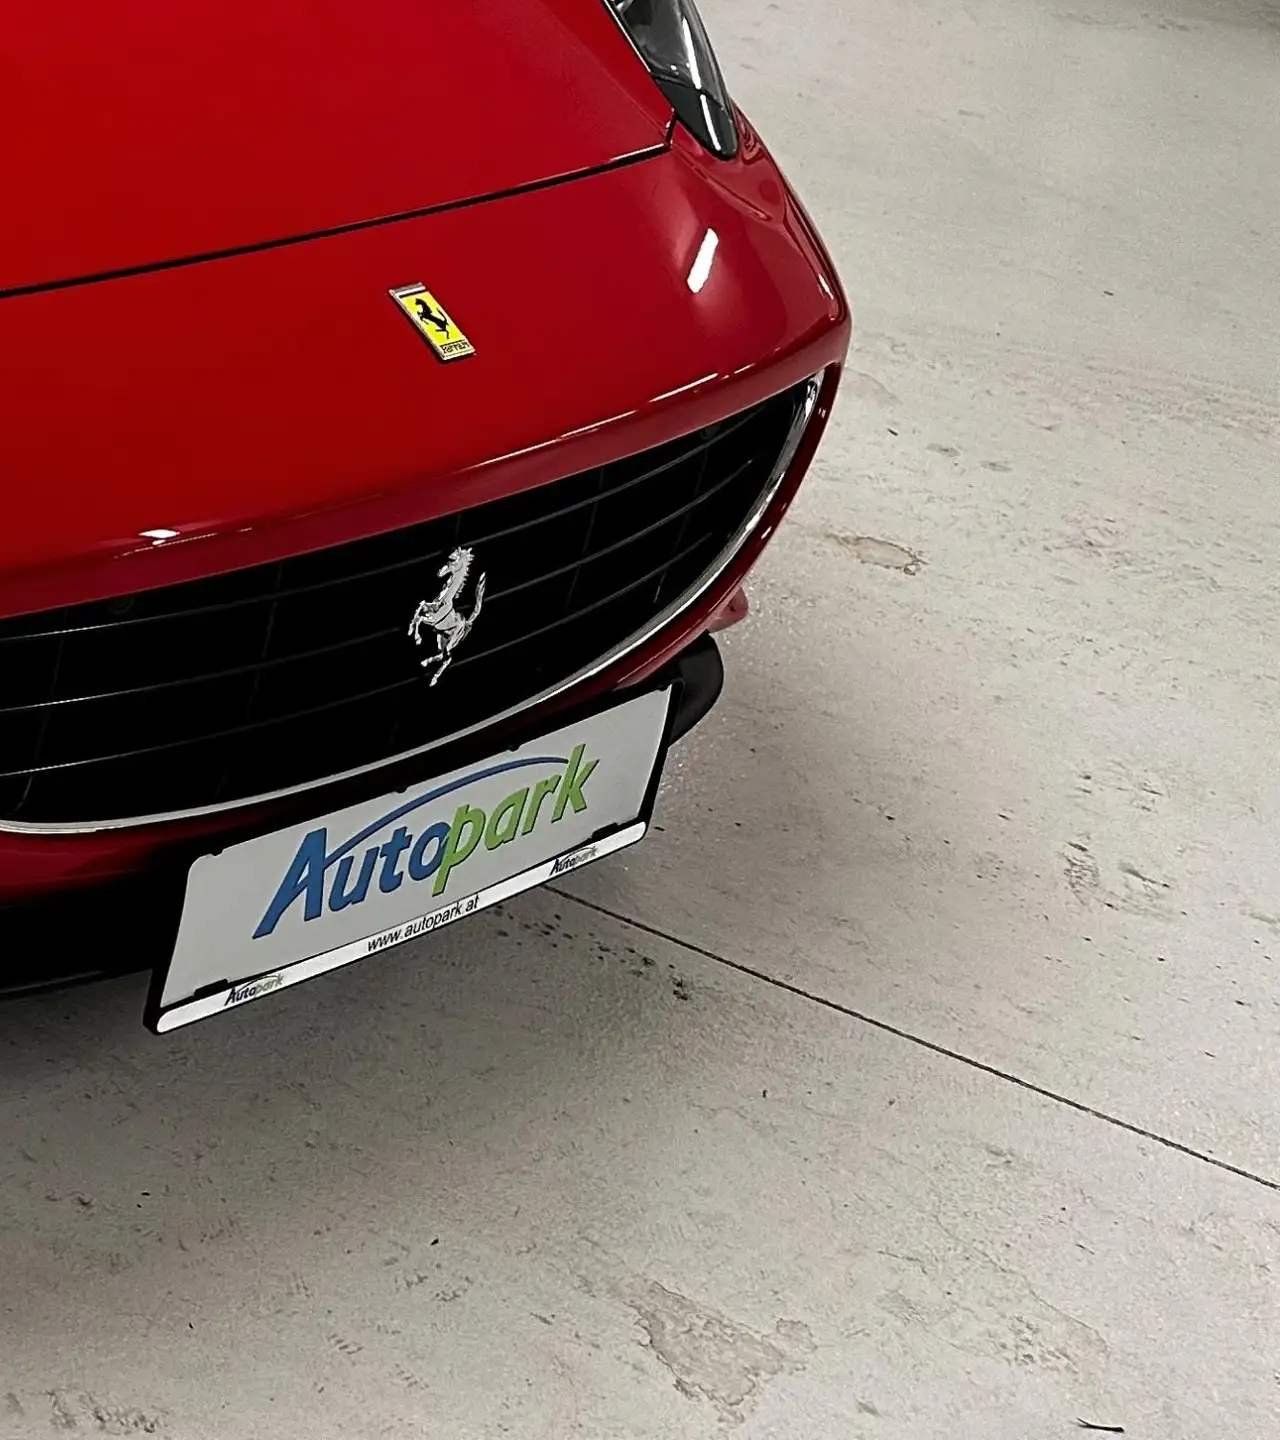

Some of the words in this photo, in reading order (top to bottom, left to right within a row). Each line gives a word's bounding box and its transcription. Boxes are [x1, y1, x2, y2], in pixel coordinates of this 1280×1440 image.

[252, 744, 600, 939] Autopark
[367, 894, 480, 952] www.autopark.at
[224, 974, 284, 1006] Autopark
